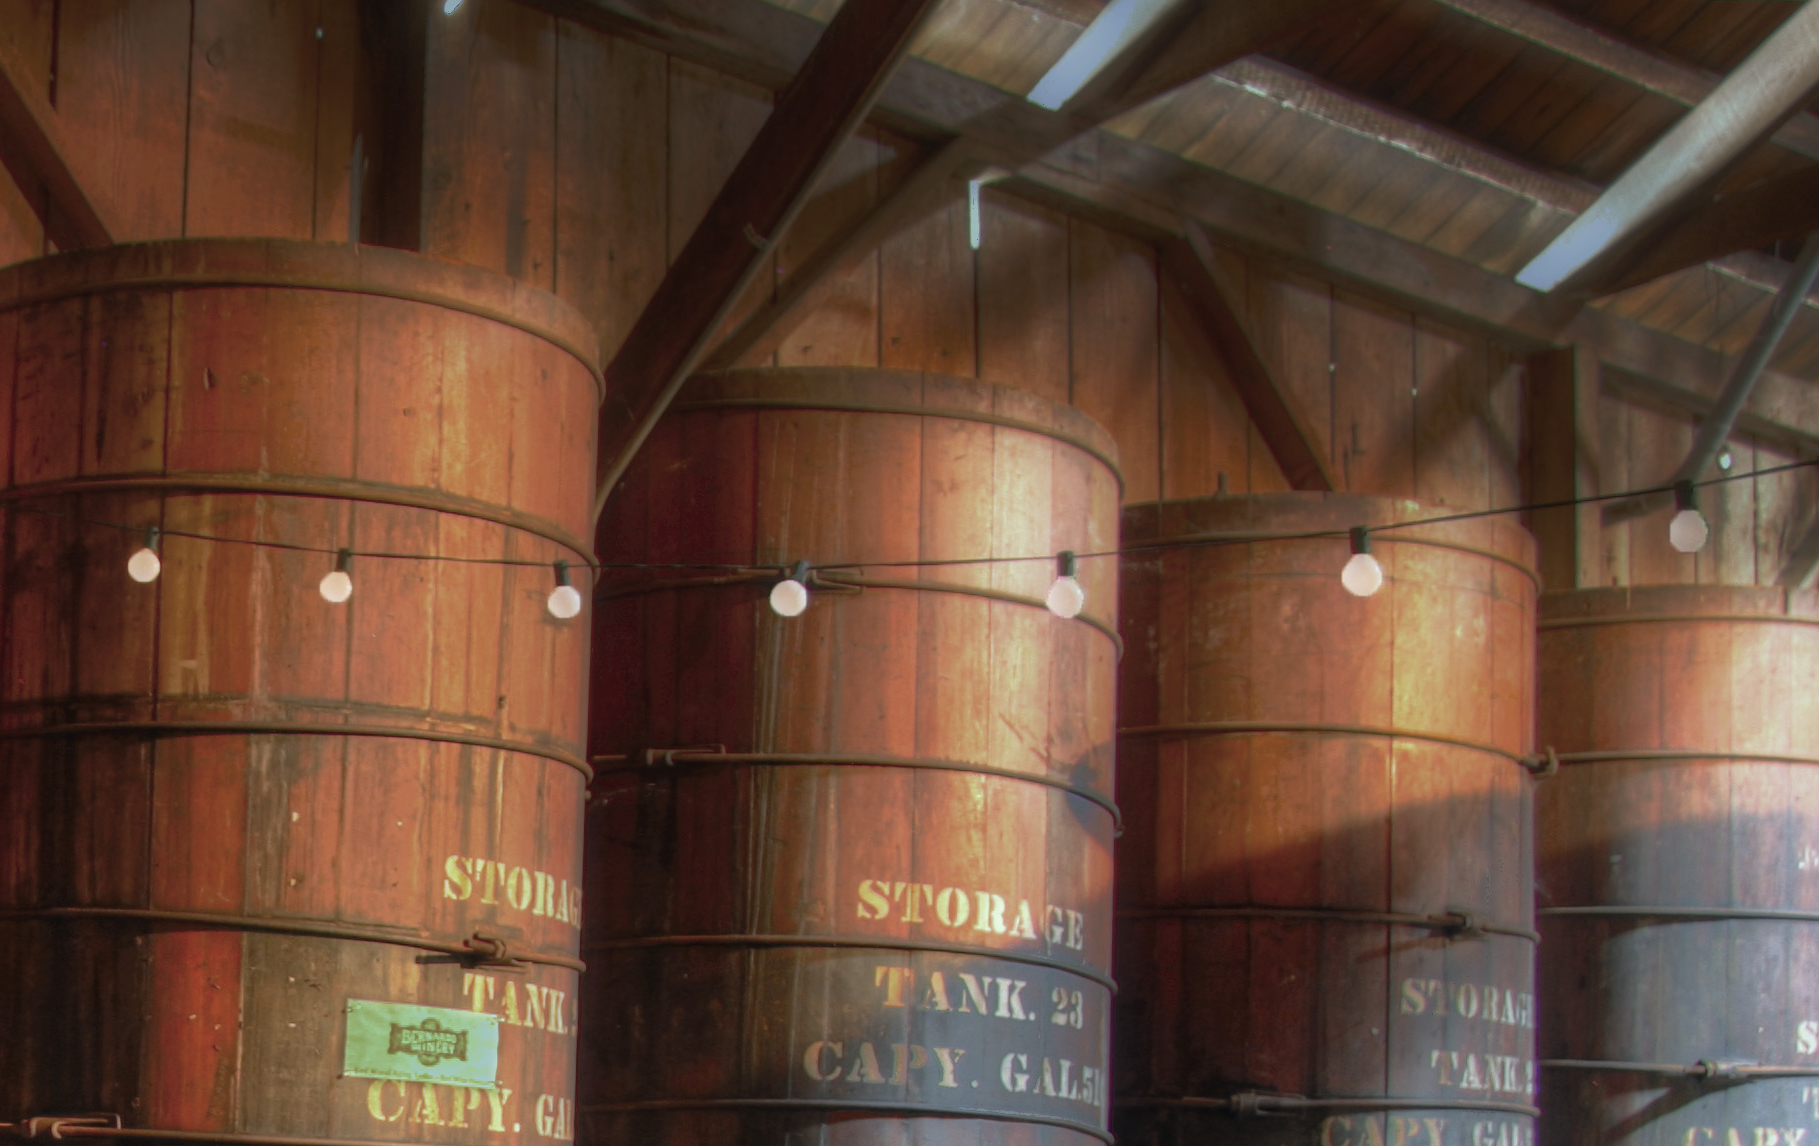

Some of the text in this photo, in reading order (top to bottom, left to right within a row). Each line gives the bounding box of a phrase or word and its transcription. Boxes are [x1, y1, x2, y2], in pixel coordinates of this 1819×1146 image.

[856, 879, 1085, 950] STORAGE
[874, 965, 1084, 1031] TANK. 23
[802, 1040, 979, 1089] CAPY.
